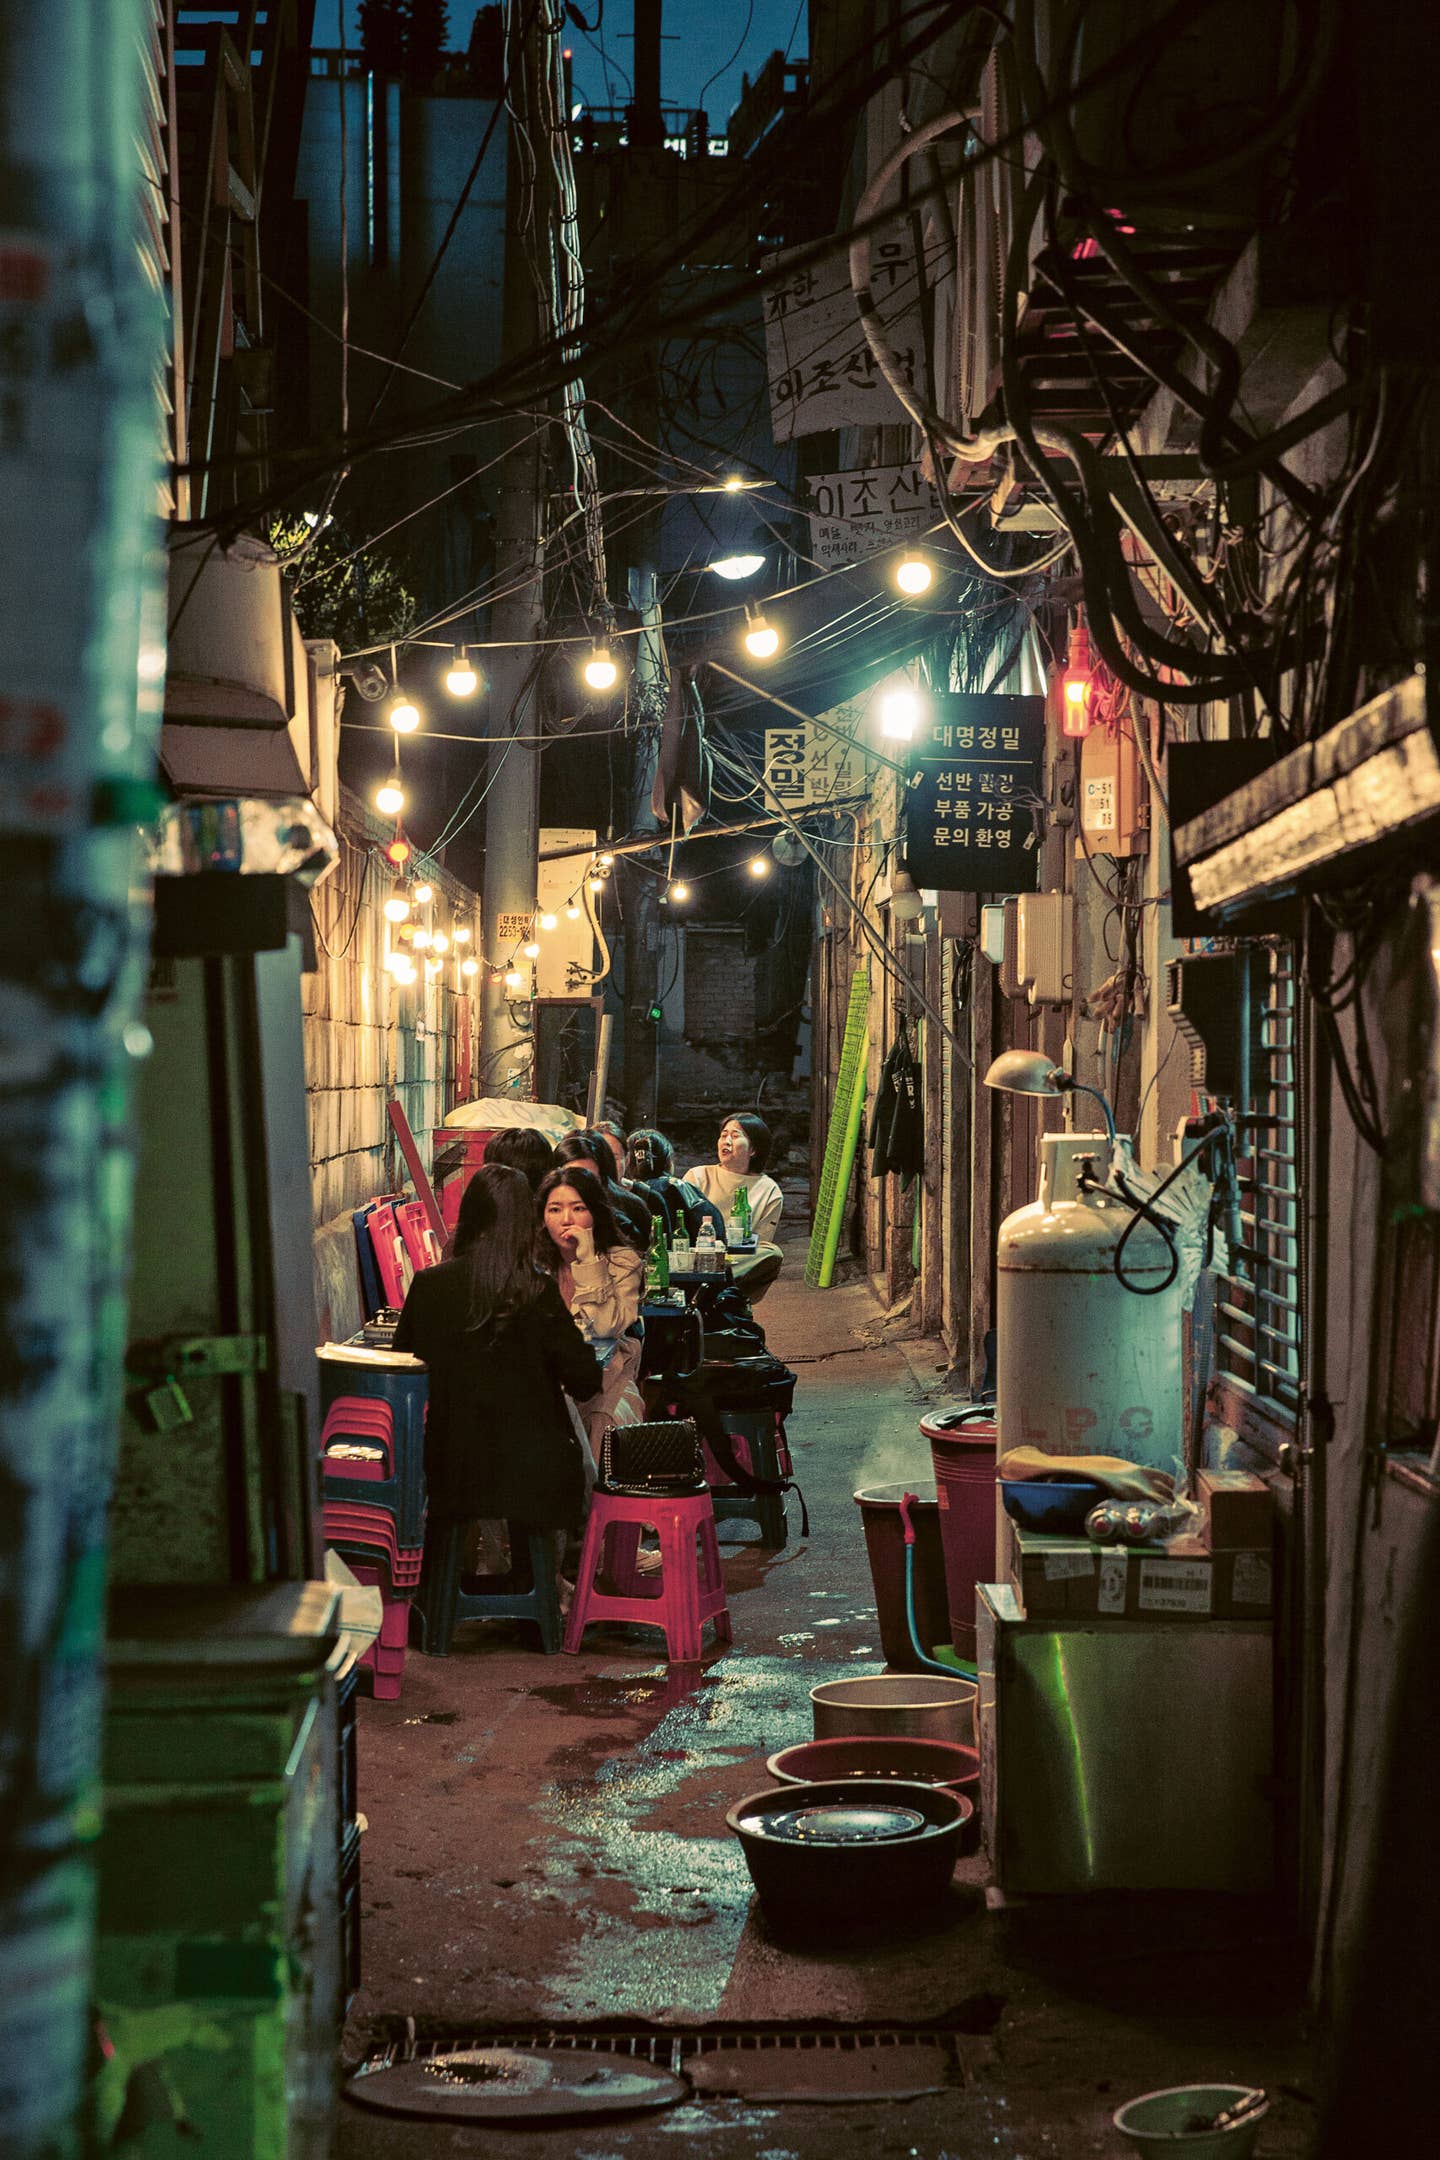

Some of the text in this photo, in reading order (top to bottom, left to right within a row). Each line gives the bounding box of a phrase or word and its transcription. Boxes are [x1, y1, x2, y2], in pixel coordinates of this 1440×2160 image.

[933, 725, 1020, 751] 대명정밀
[770, 734, 806, 798] 정밀
[936, 772, 973, 792] 선반
[934, 799, 1014, 821] 부품 가공
[933, 827, 1011, 849] 문의 환영
[1022, 1406, 1154, 1440] LPG
